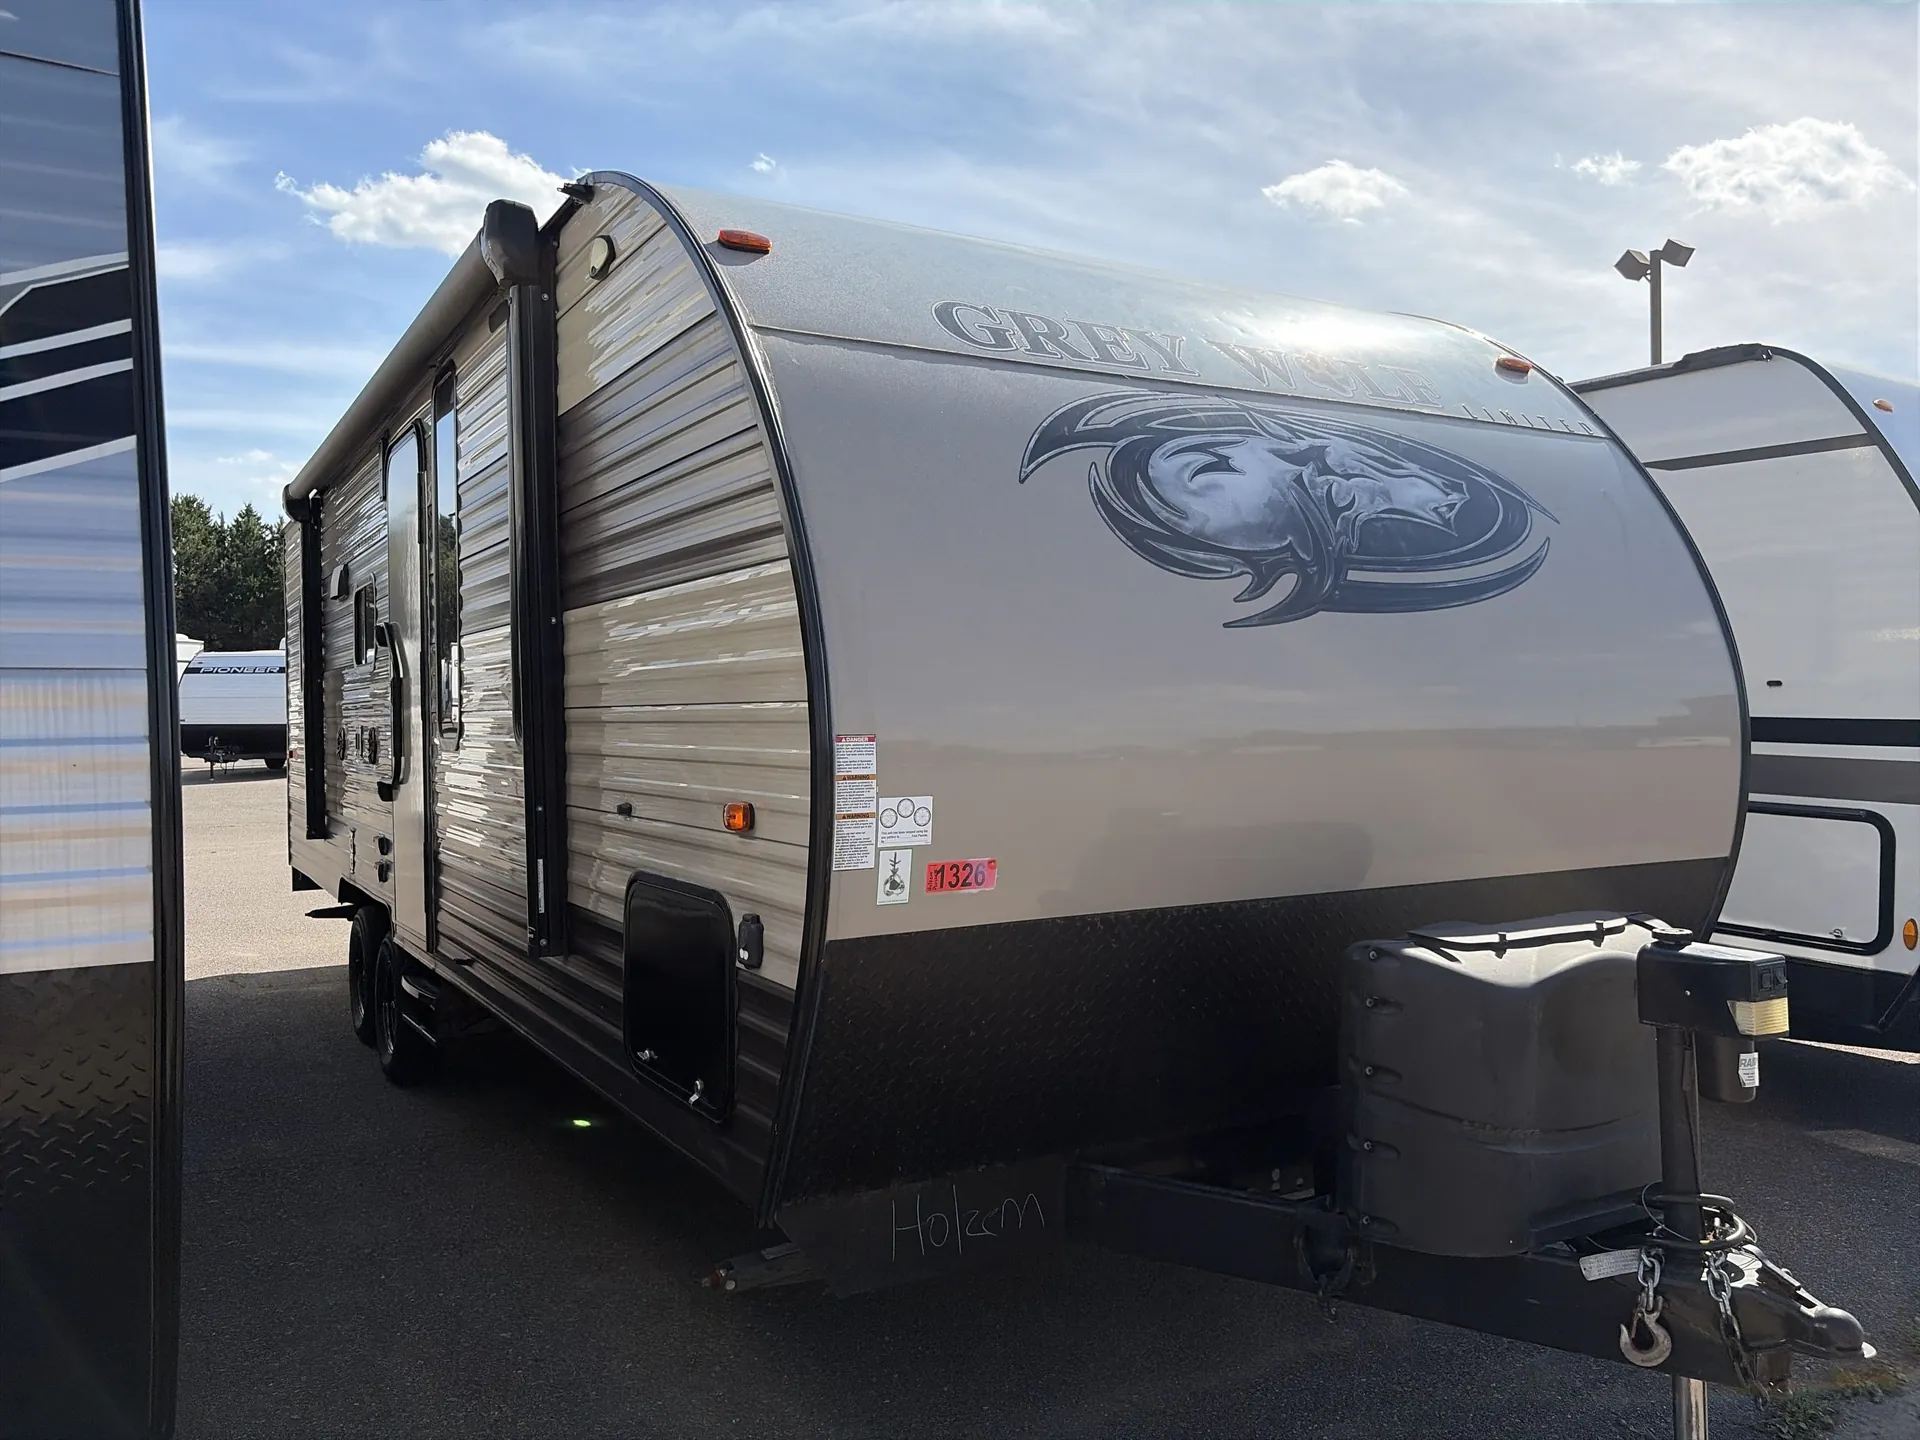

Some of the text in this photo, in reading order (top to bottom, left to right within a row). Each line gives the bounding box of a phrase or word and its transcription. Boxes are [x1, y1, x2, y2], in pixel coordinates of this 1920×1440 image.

[931, 300, 1442, 408] GREY WOLF
[1461, 403, 1595, 436] LIMITED
[935, 862, 986, 889] 1326
